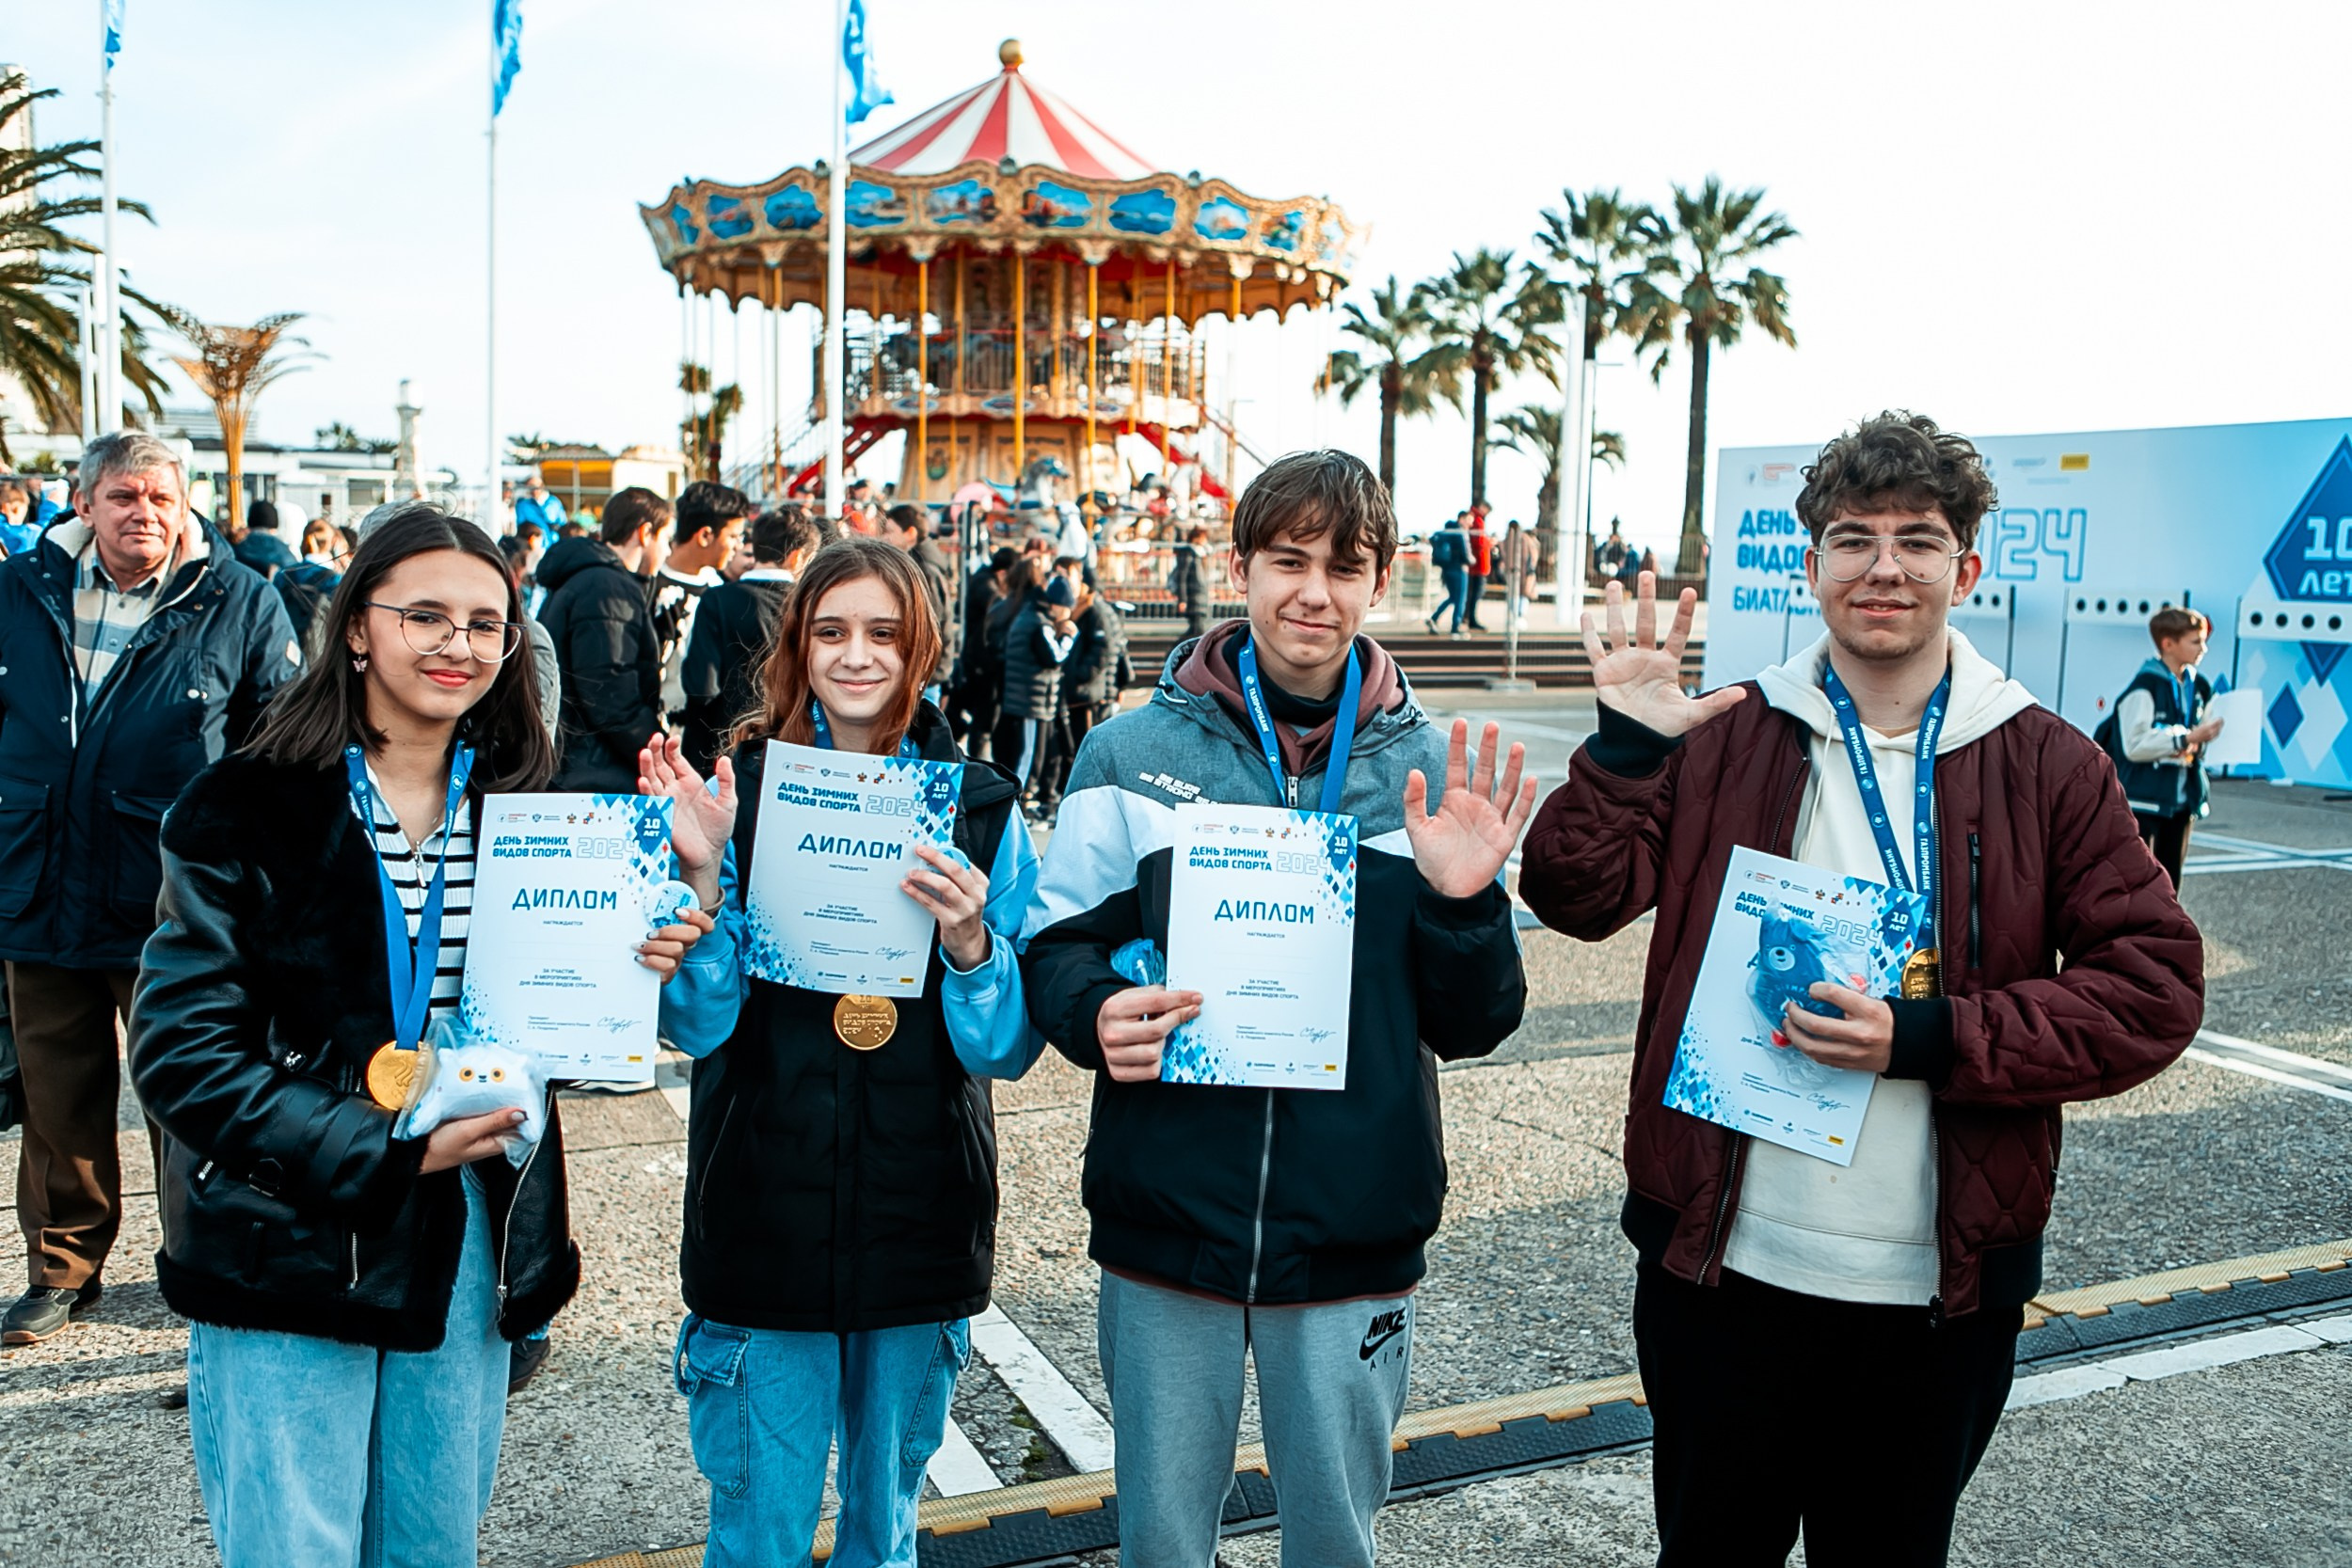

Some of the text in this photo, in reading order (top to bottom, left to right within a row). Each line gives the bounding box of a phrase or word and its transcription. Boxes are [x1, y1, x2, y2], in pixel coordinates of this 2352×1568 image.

[1738, 509, 1796, 539] ДЕНЬ
[1848, 727, 1868, 774] ГАЗПРОМБАНК
[778, 782, 859, 801] ДЕНЬ ЗИМНИХ
[932, 782, 949, 793] 10
[777, 791, 861, 813] ВИДОВ СПОРТА
[866, 795, 928, 817] 2024
[644, 817, 660, 829] 10
[492, 847, 572, 858] ВИДОВ СПОРТА
[494, 836, 569, 847] ДЕНЬ ЗИМНИХ
[577, 837, 640, 860] 2024
[798, 833, 903, 861] ДИПЛОМ
[1189, 846, 1268, 859] ДЕНЬ ЗИМНИХ
[1334, 836, 1347, 847] 10
[829, 863, 868, 872] НАГРАЖДАЕТСЯ
[1189, 858, 1272, 871] ВИДОВ СПОРТА
[1276, 851, 1332, 876] 2024
[1920, 838, 1931, 890] ГАЗПРОМБАНК
[512, 889, 617, 911] ДИПЛОМ
[1734, 902, 1766, 918] ВИДО
[1736, 891, 1815, 920] ДЕНЬ МНИХ
[1215, 899, 1314, 925] ДИПЛОМ
[1891, 911, 1909, 925] 10
[1821, 914, 1884, 950] 2024
[1366, 1307, 1406, 1339] NIKE
[1370, 1346, 1404, 1372] AIR
